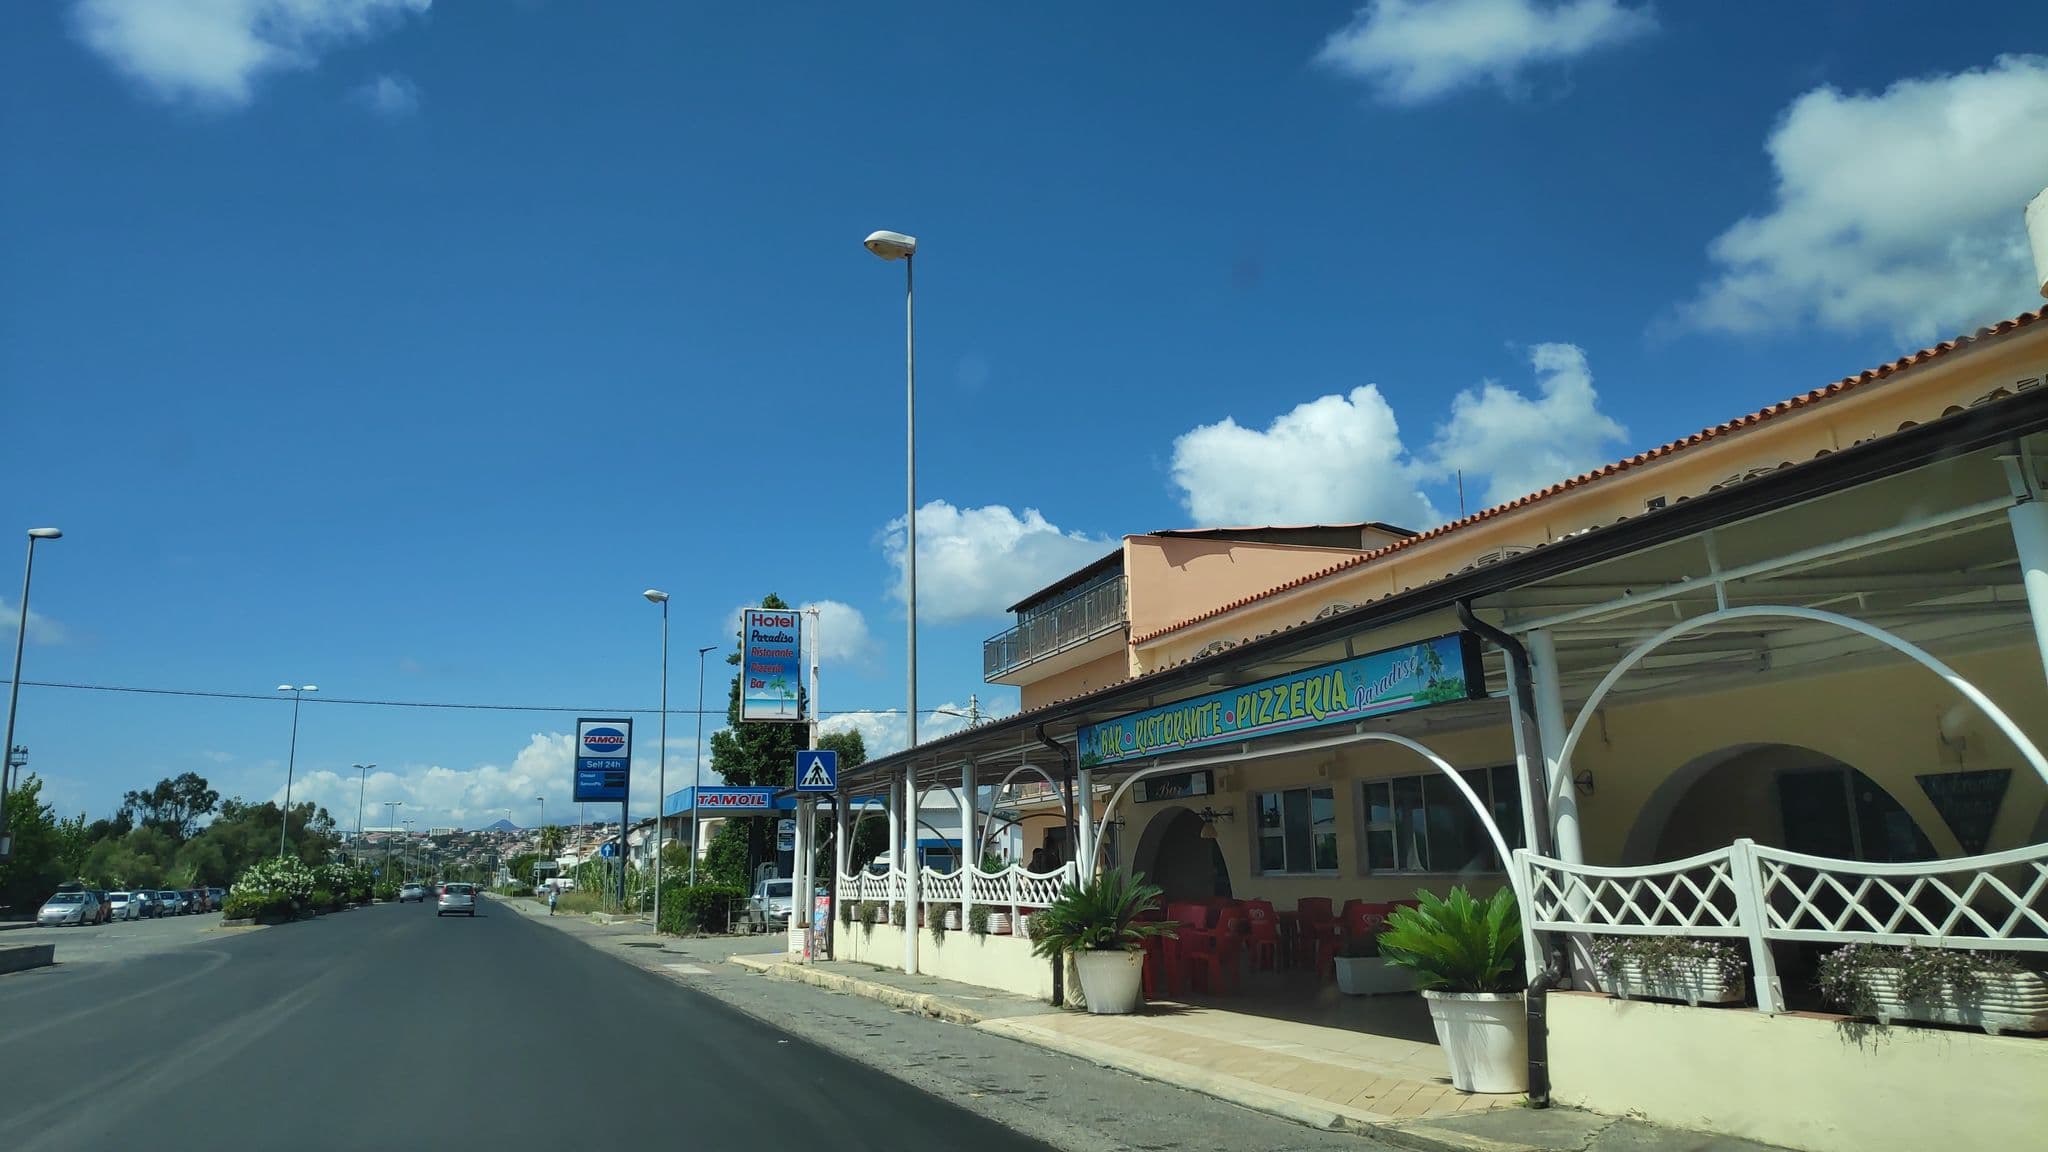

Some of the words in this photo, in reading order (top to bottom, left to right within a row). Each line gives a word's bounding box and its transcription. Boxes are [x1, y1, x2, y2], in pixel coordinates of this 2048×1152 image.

[752, 613, 794, 628] Hotel
[752, 629, 794, 643] Paradiso
[751, 677, 767, 689] Bar
[1101, 724, 1126, 760] BAR
[1135, 701, 1223, 755] RISTORANTE
[1236, 669, 1349, 730] PIZZERIA
[584, 736, 625, 744] TAMOIL
[586, 760, 603, 769] Self
[605, 760, 621, 769] 24h
[698, 794, 767, 805] TAMOIL
